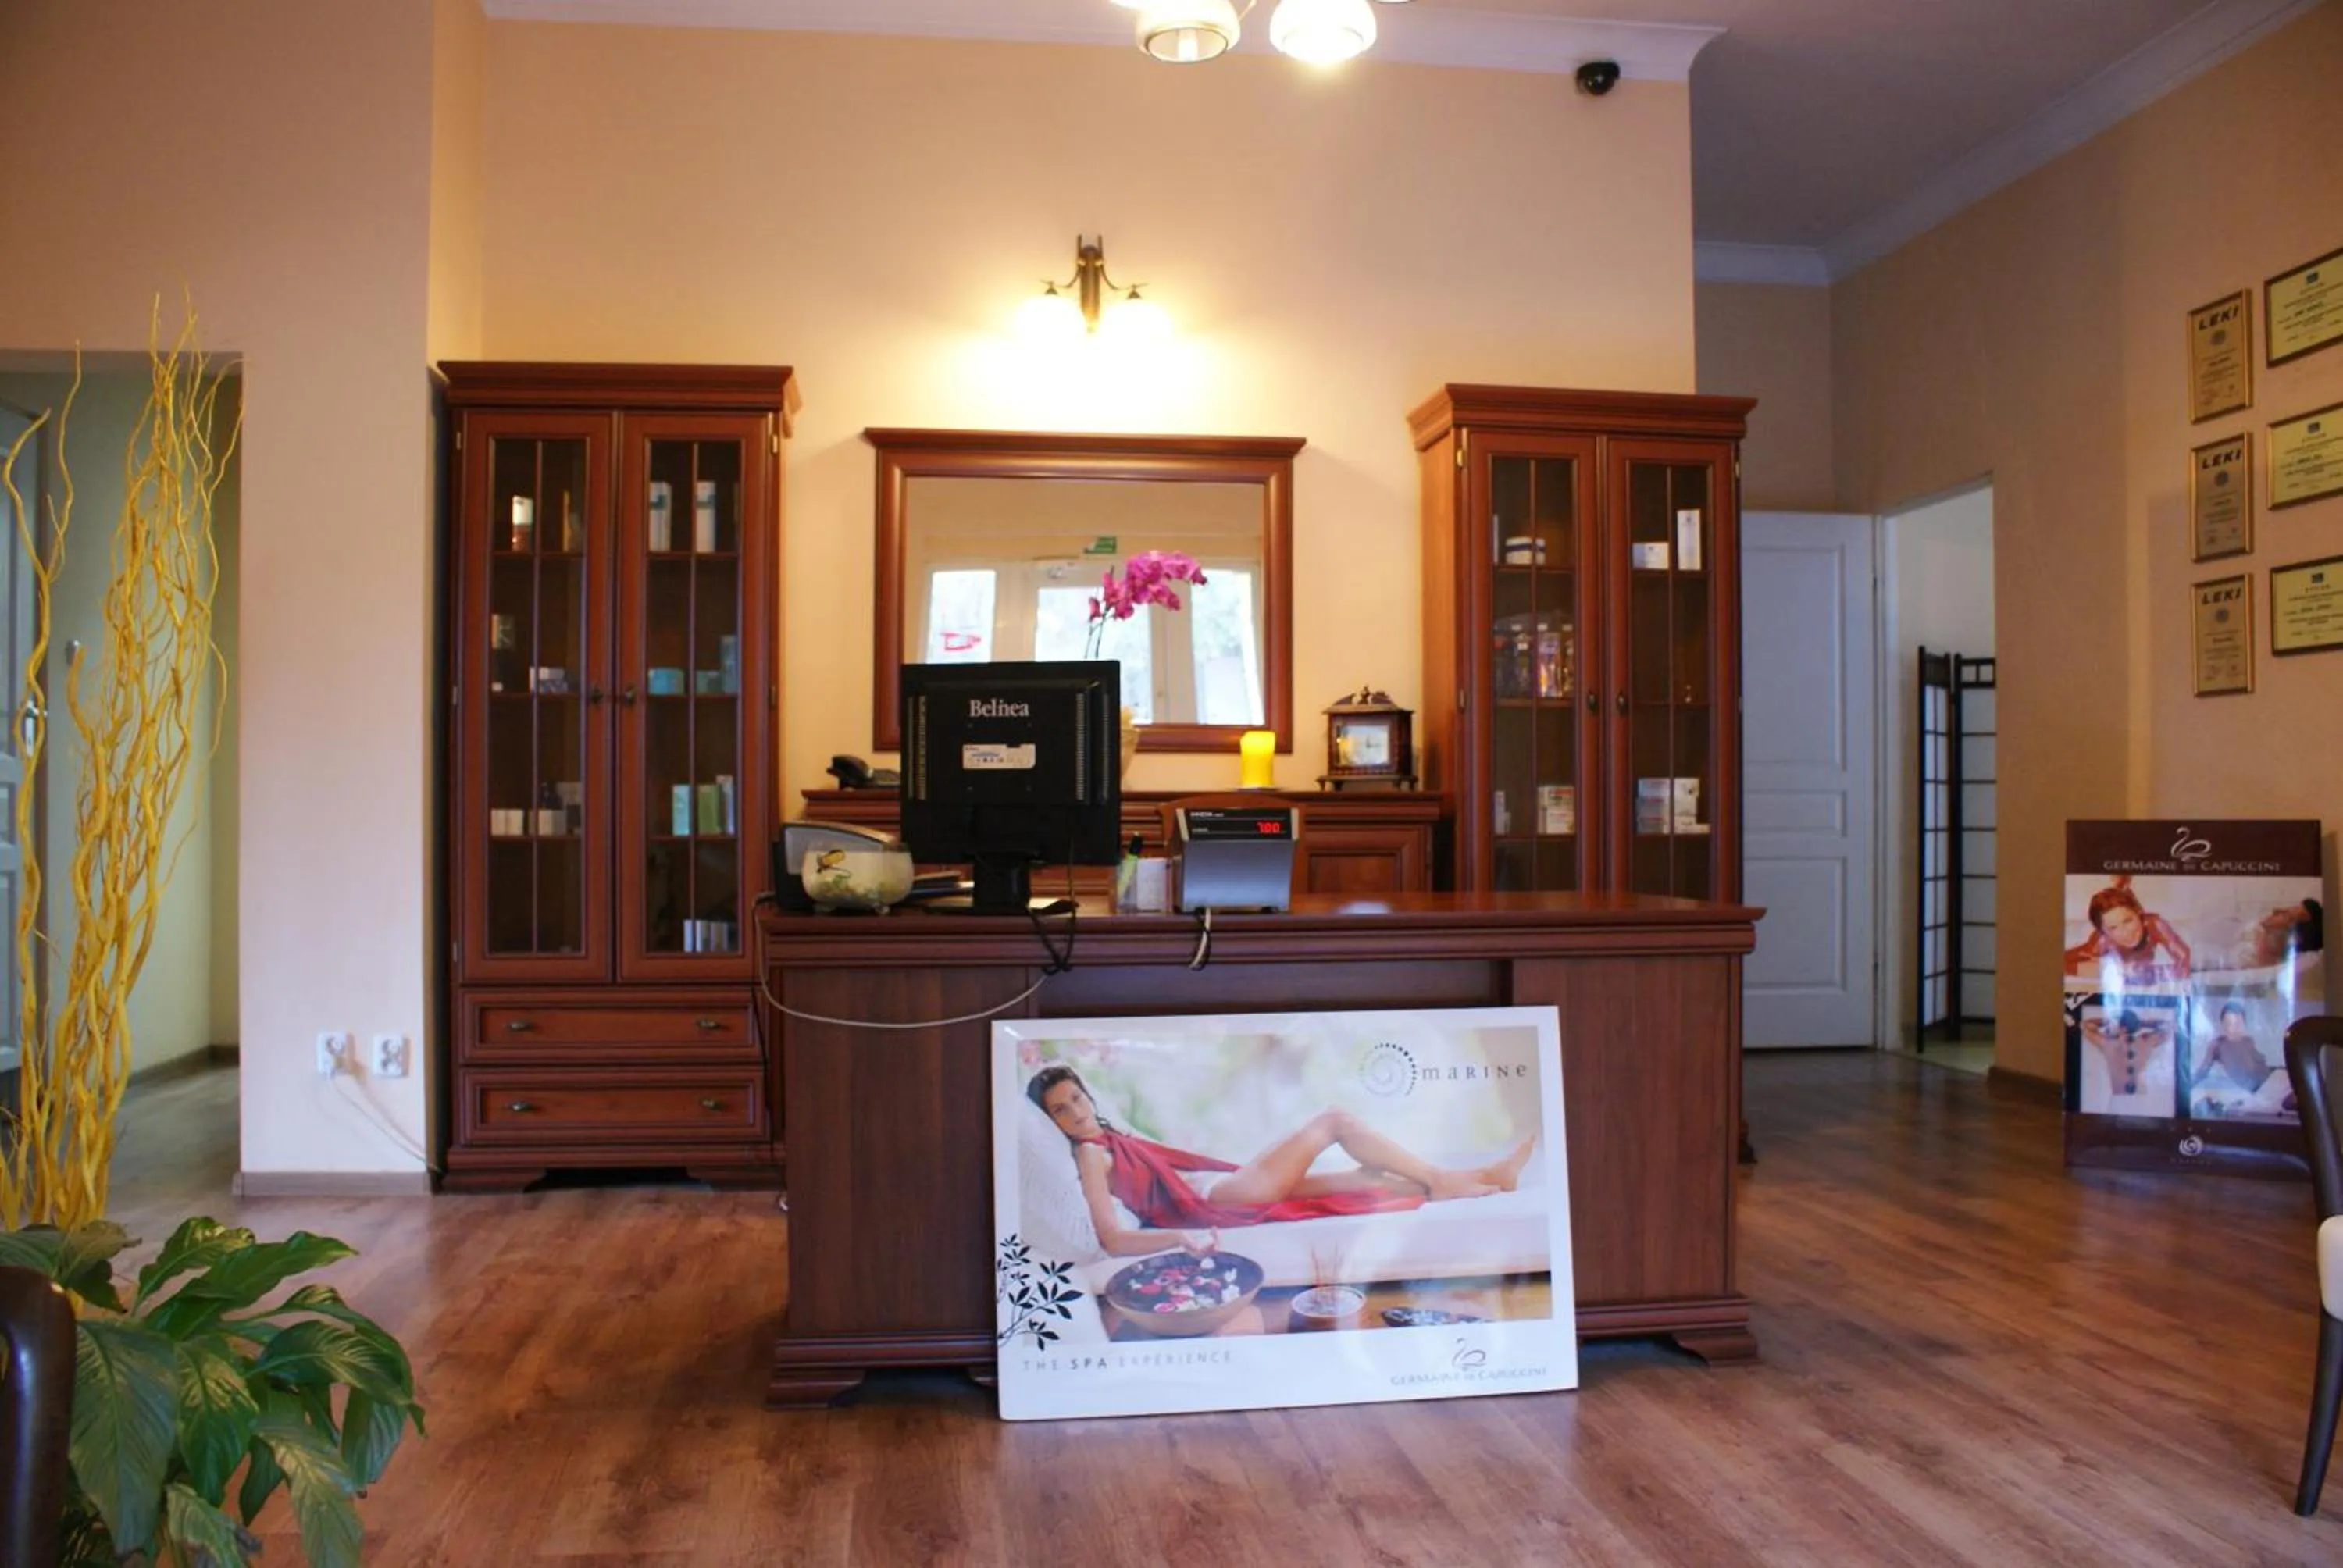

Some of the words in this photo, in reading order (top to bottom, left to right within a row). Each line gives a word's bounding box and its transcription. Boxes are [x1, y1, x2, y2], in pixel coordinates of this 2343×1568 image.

[2199, 305, 2239, 331] LEKI
[2202, 449, 2241, 469] LEKI
[2202, 587, 2241, 605] LEKI
[969, 698, 1029, 717] Belinea
[2102, 860, 2177, 871] GERMAINE
[2200, 861, 2281, 872] CAPUCCINI
[1023, 1359, 1059, 1371] THE
[1071, 1357, 1108, 1370] SPA
[1118, 1351, 1232, 1368] EXPERIENCE
